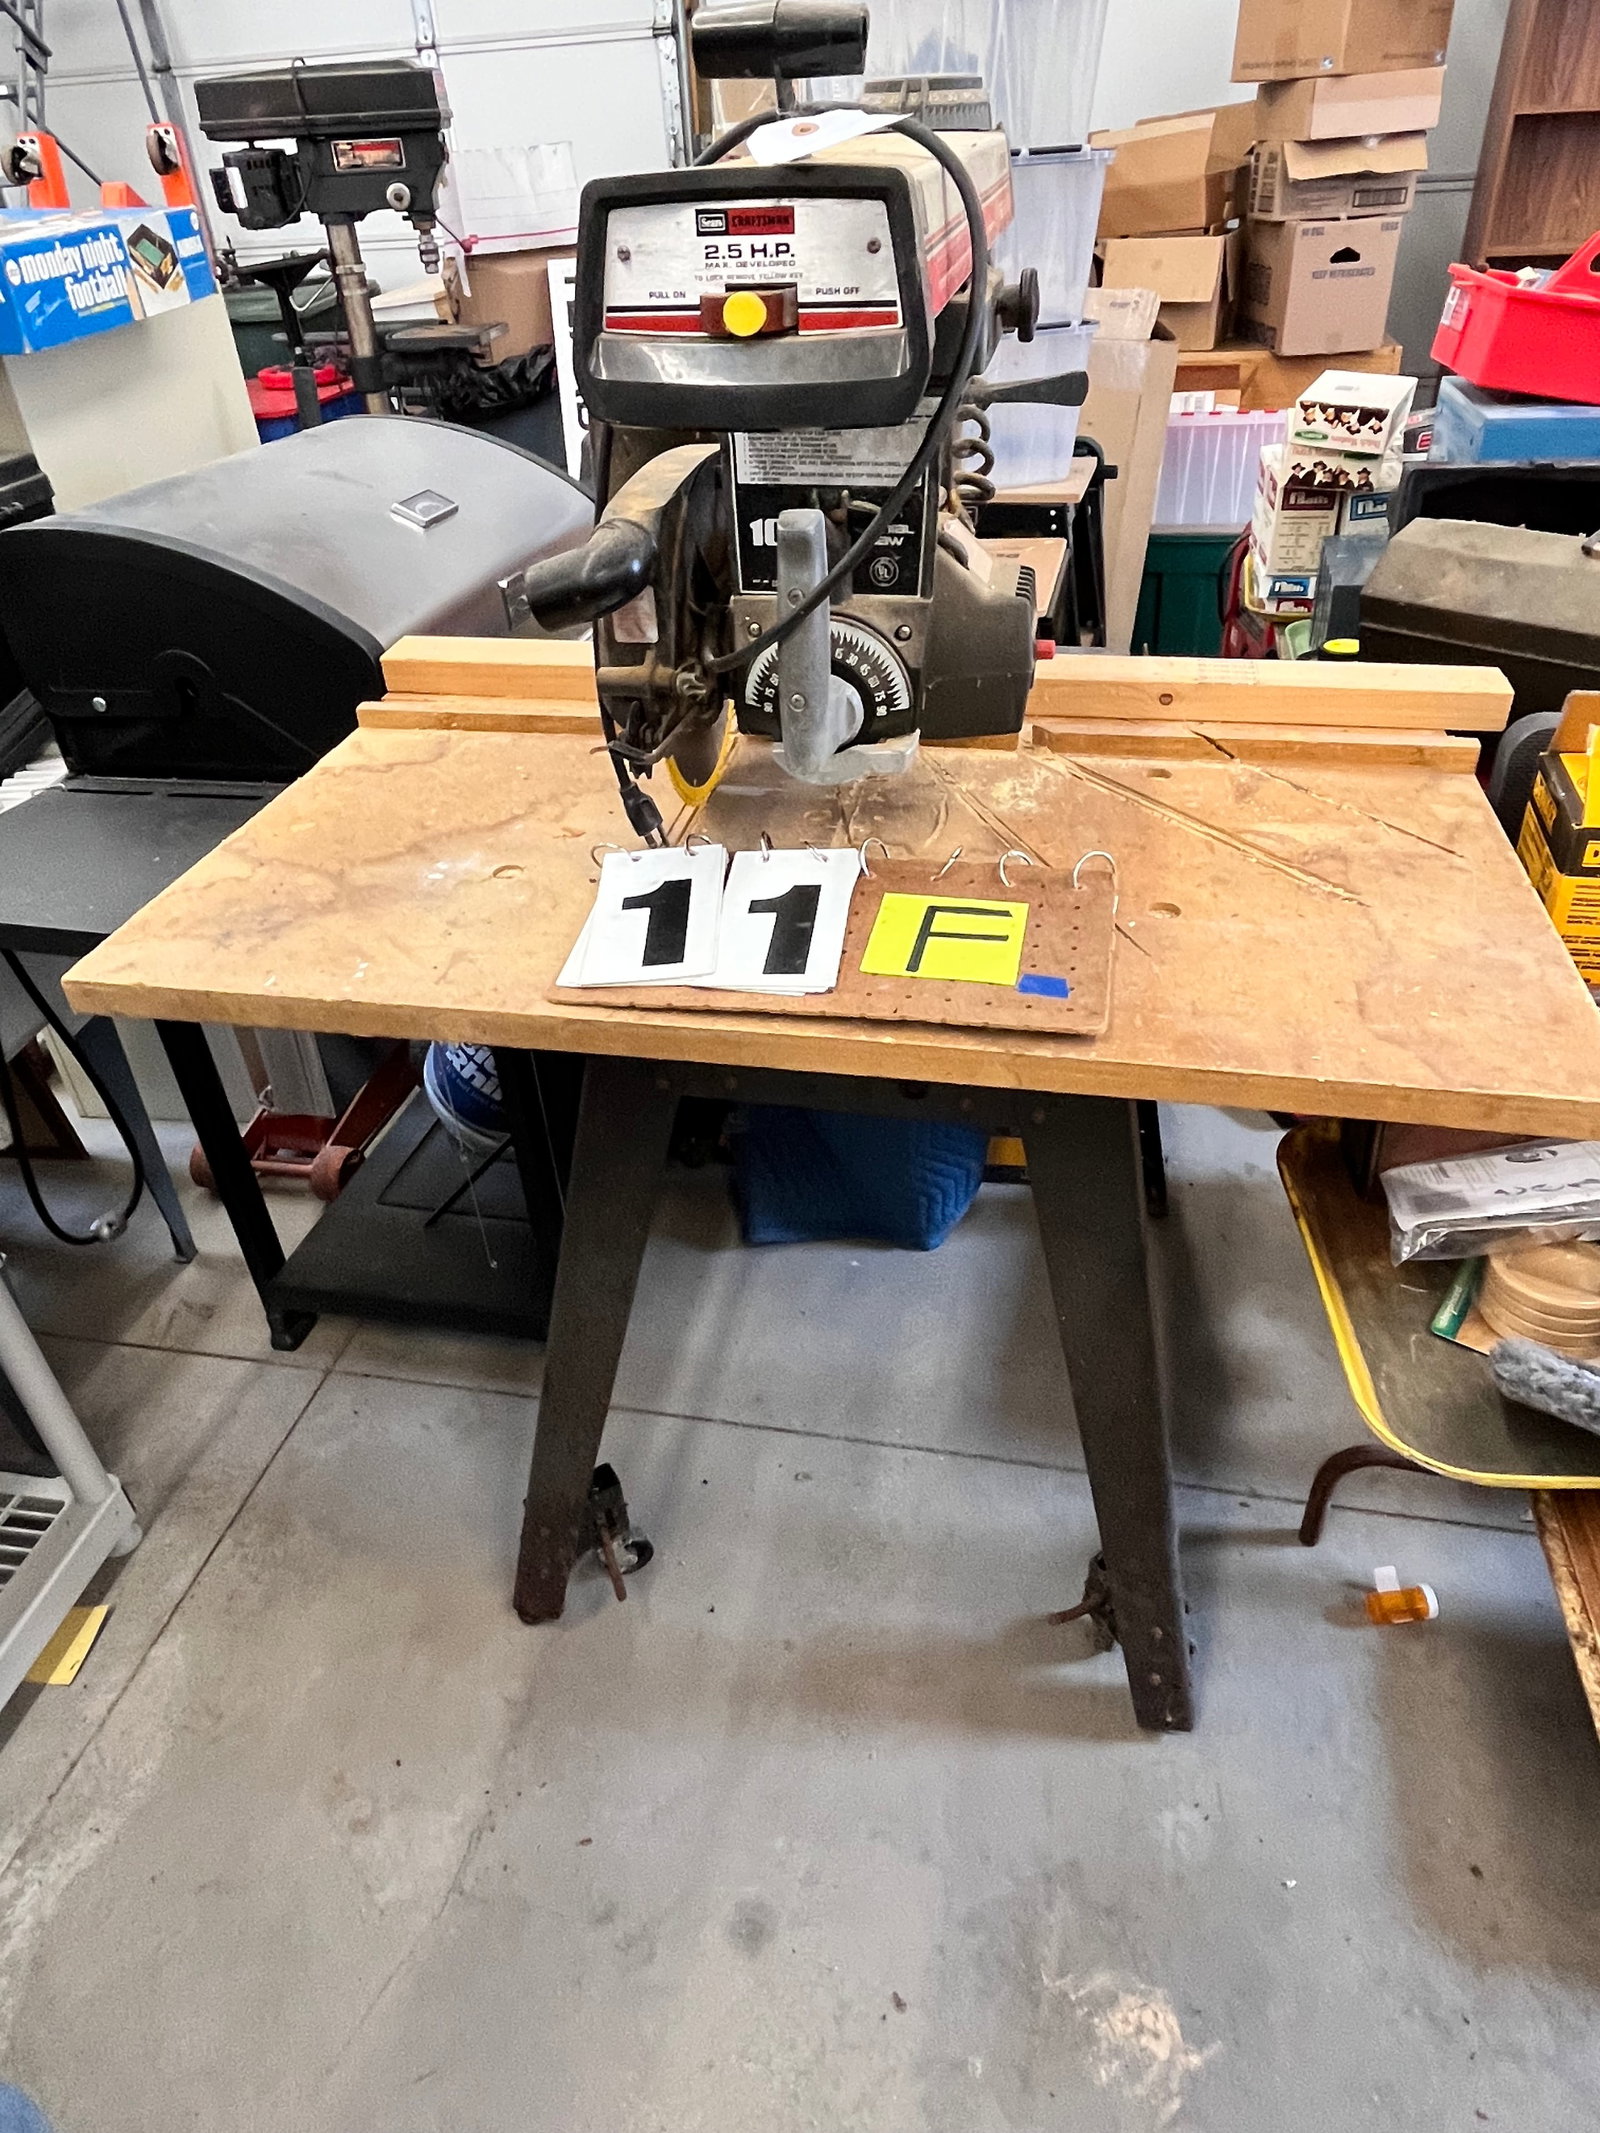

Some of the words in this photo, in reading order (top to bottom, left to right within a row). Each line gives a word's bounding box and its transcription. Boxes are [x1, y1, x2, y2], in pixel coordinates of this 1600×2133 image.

[701, 217, 723, 228] Sears
[731, 214, 790, 227] CRAFTSMAN
[18, 241, 83, 284] monday
[80, 231, 125, 272] night
[704, 243, 742, 260] 2.5
[750, 242, 795, 259] H.P.
[735, 259, 796, 268] DEVELOPED
[65, 265, 128, 311] football
[648, 290, 670, 299] PULL
[672, 290, 686, 299] ON
[815, 287, 841, 295] PUSH
[843, 286, 861, 295] OFF
[845, 652, 859, 667] 30
[859, 663, 872, 677] 45
[905, 904, 1014, 973] F
